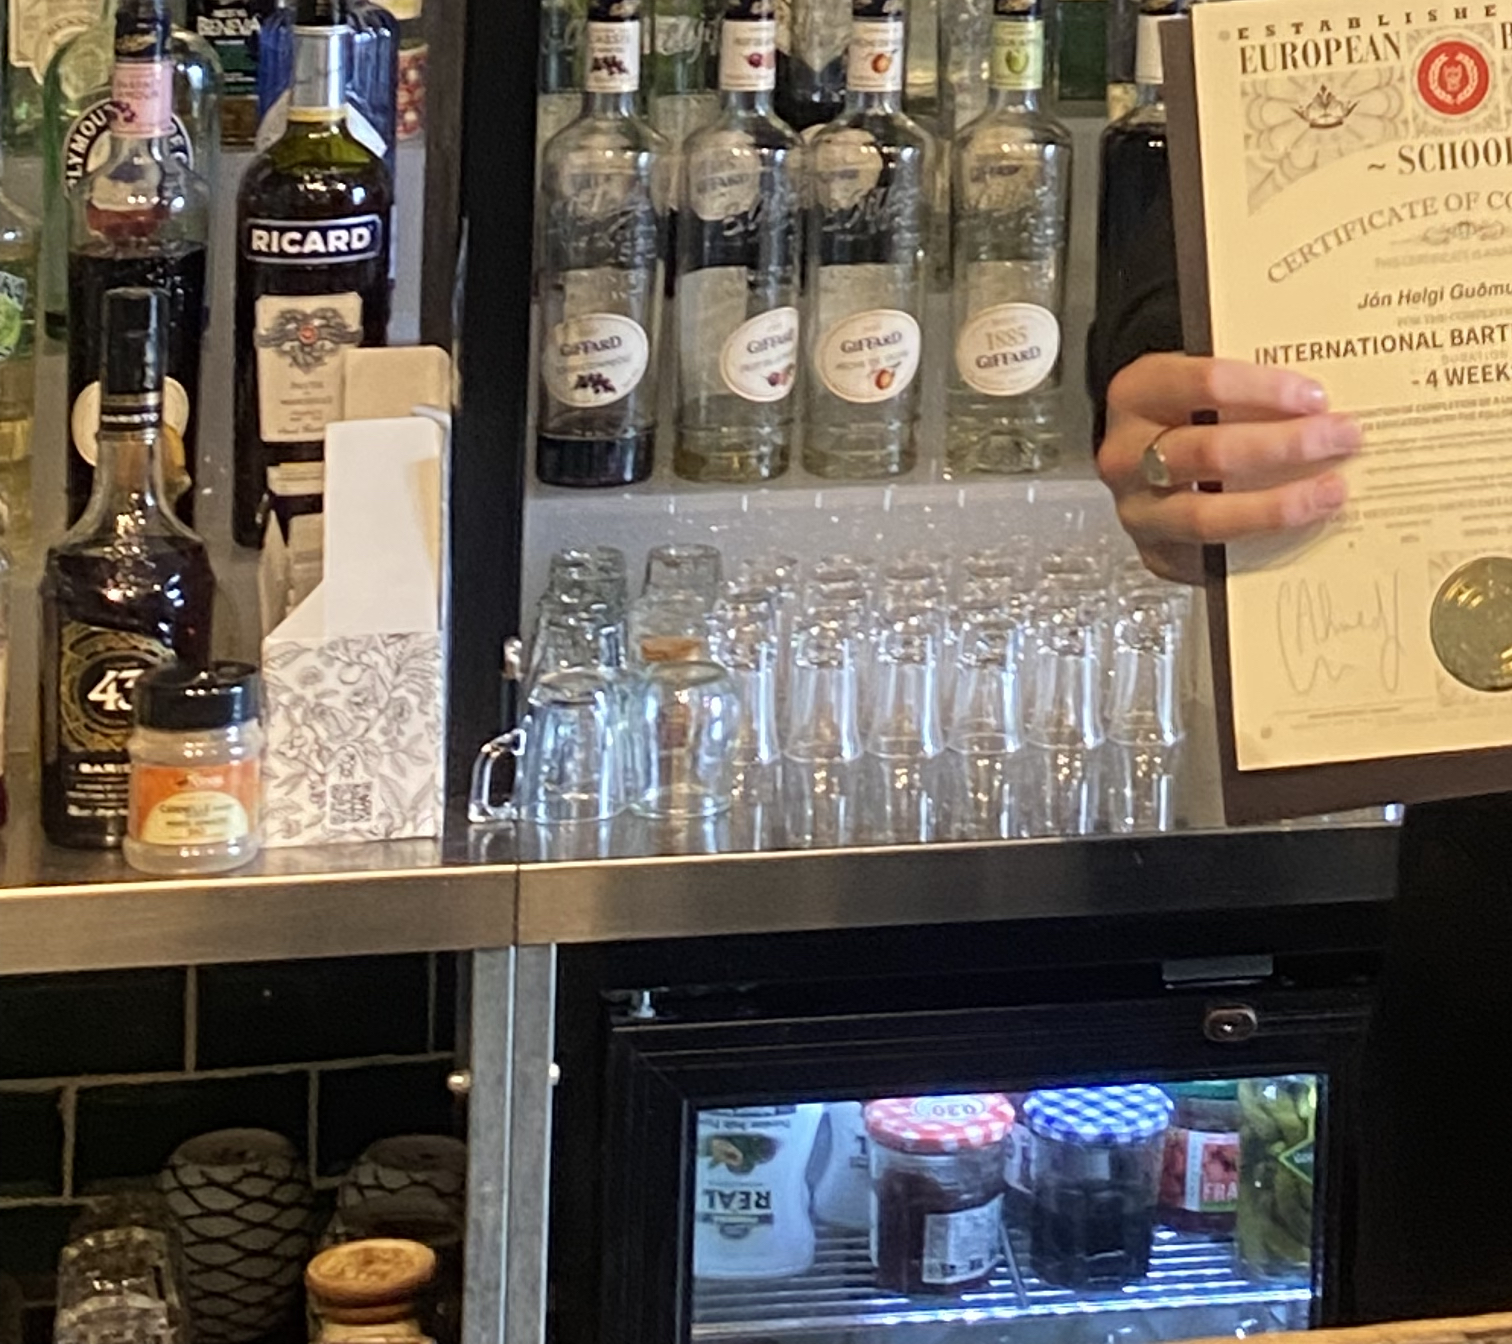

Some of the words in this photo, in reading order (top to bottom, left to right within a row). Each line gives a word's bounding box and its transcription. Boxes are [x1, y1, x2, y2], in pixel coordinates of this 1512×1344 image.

[1239, 31, 1403, 75] EUROPEAN
[251, 224, 372, 255] RICARD
[1265, 197, 1439, 286] CERTIFICATE
[1444, 190, 1480, 213] OF
[1397, 286, 1445, 308] Helgi
[1255, 330, 1444, 367] INTERNATIONAL
[1424, 368, 1440, 390] 4
